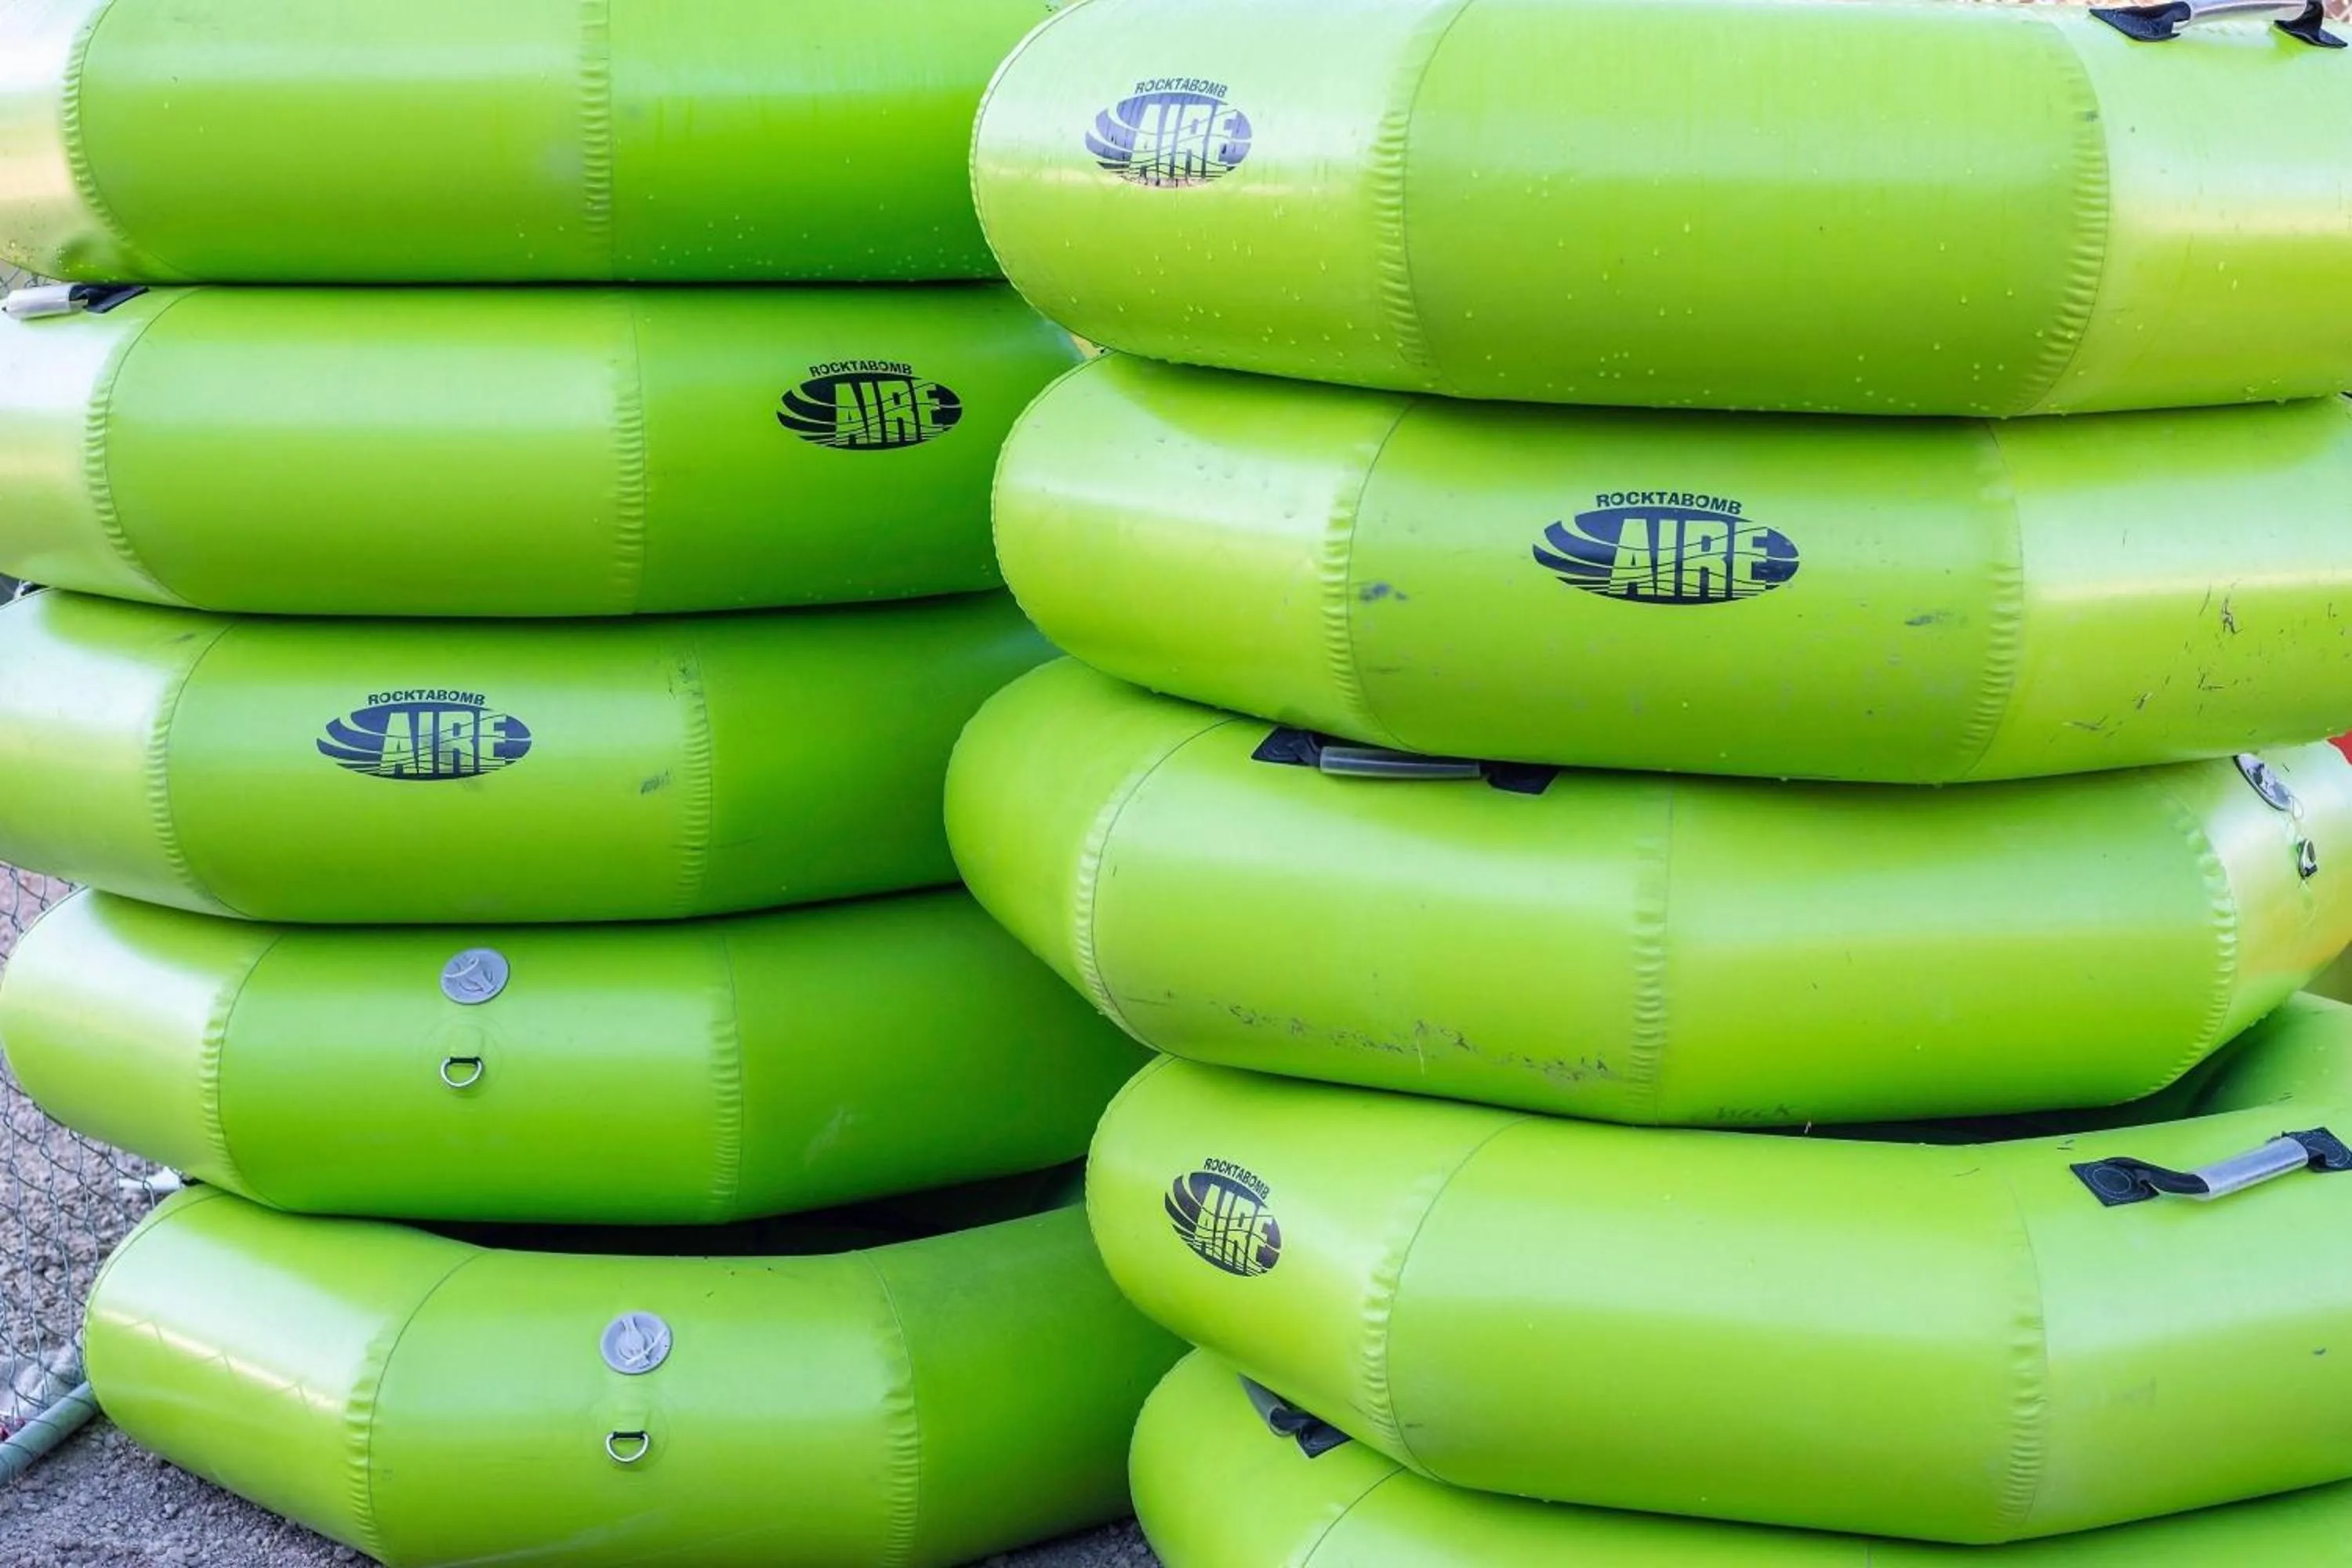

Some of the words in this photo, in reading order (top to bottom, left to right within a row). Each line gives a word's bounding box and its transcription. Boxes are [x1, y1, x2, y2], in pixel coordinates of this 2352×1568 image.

[1134, 78, 1228, 98] ROCKTABOMB
[809, 360, 913, 376] ROCKTABOMB
[1595, 492, 1742, 515] ROCKTABOMB
[368, 689, 486, 706] ROCKTABOMB
[1203, 1158, 1270, 1200] ROCKTABOMB
